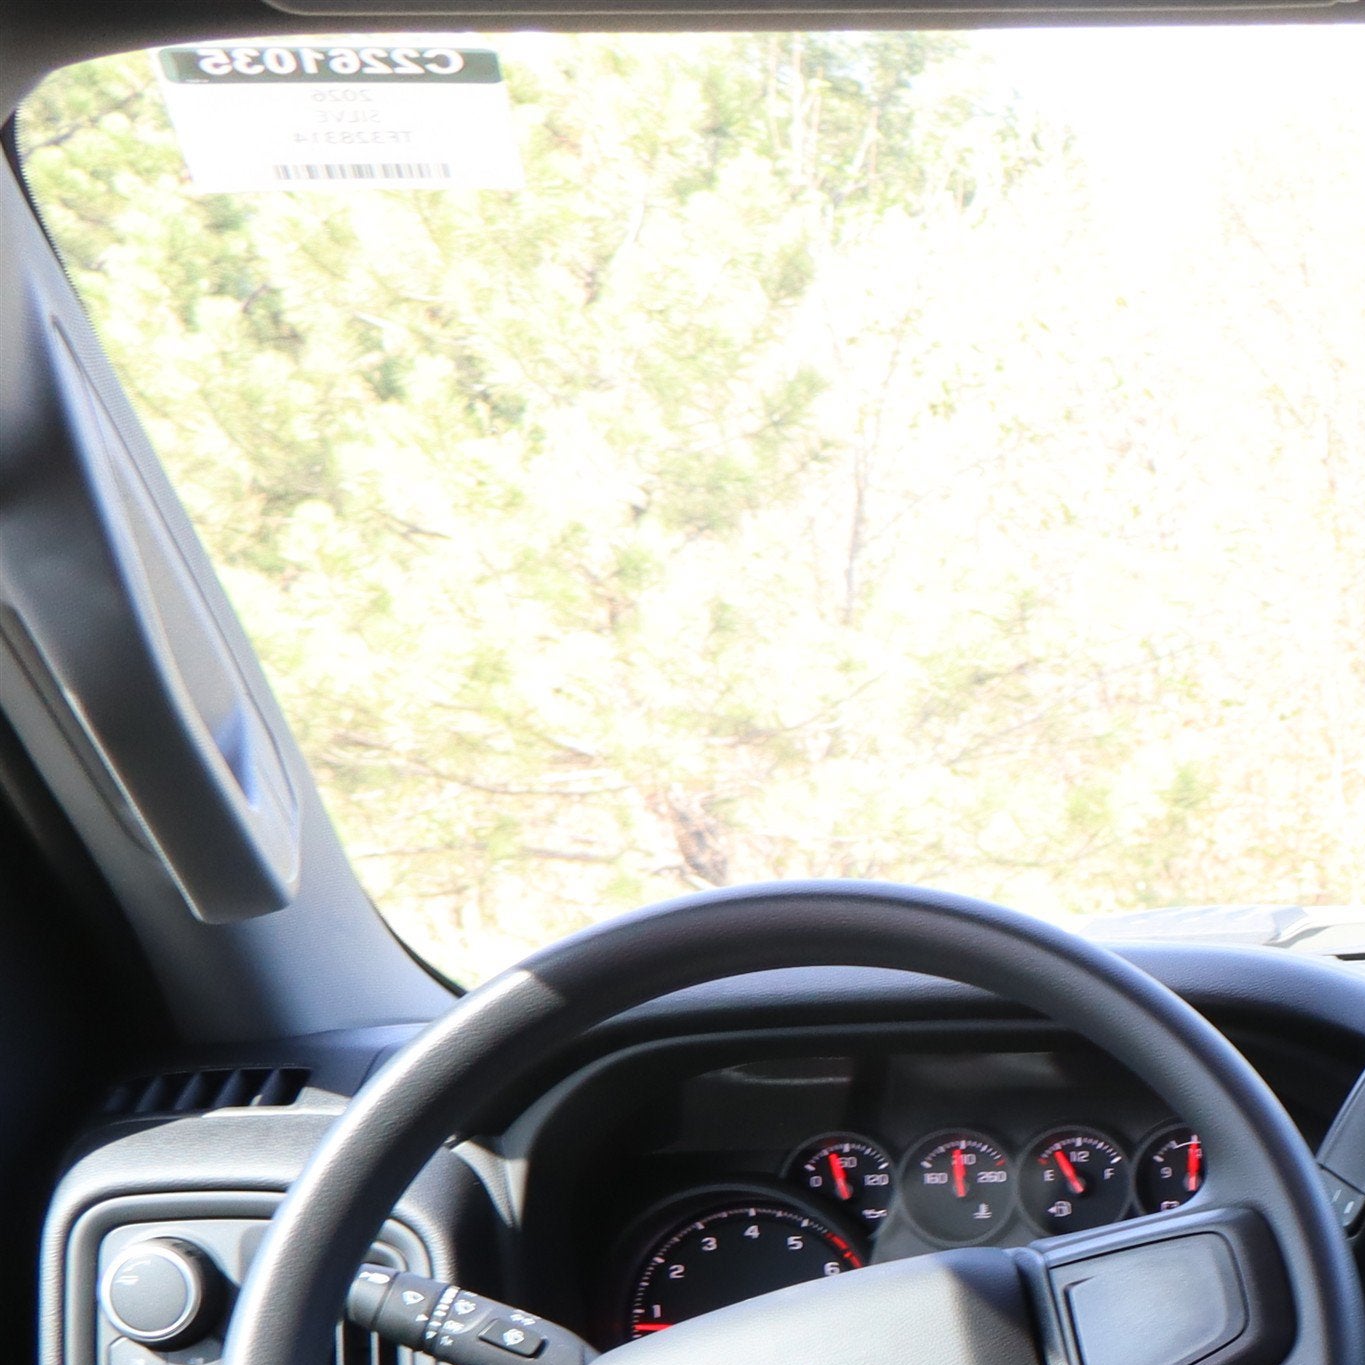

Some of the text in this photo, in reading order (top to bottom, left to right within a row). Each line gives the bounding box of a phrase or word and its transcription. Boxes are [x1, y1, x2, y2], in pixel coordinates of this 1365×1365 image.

[923, 1172, 948, 1185] 160
[977, 1170, 1008, 1183] 260
[1043, 1169, 1055, 1182] E
[1103, 1167, 1116, 1180] F
[1160, 1166, 1173, 1179] 9
[809, 1175, 823, 1188] 0
[863, 1173, 889, 1187] 120
[743, 1224, 761, 1240] 4
[700, 1236, 718, 1252] 3
[786, 1235, 804, 1251] 5
[669, 1264, 685, 1279] 2
[823, 1261, 841, 1277] 6
[652, 1303, 662, 1318] 1
